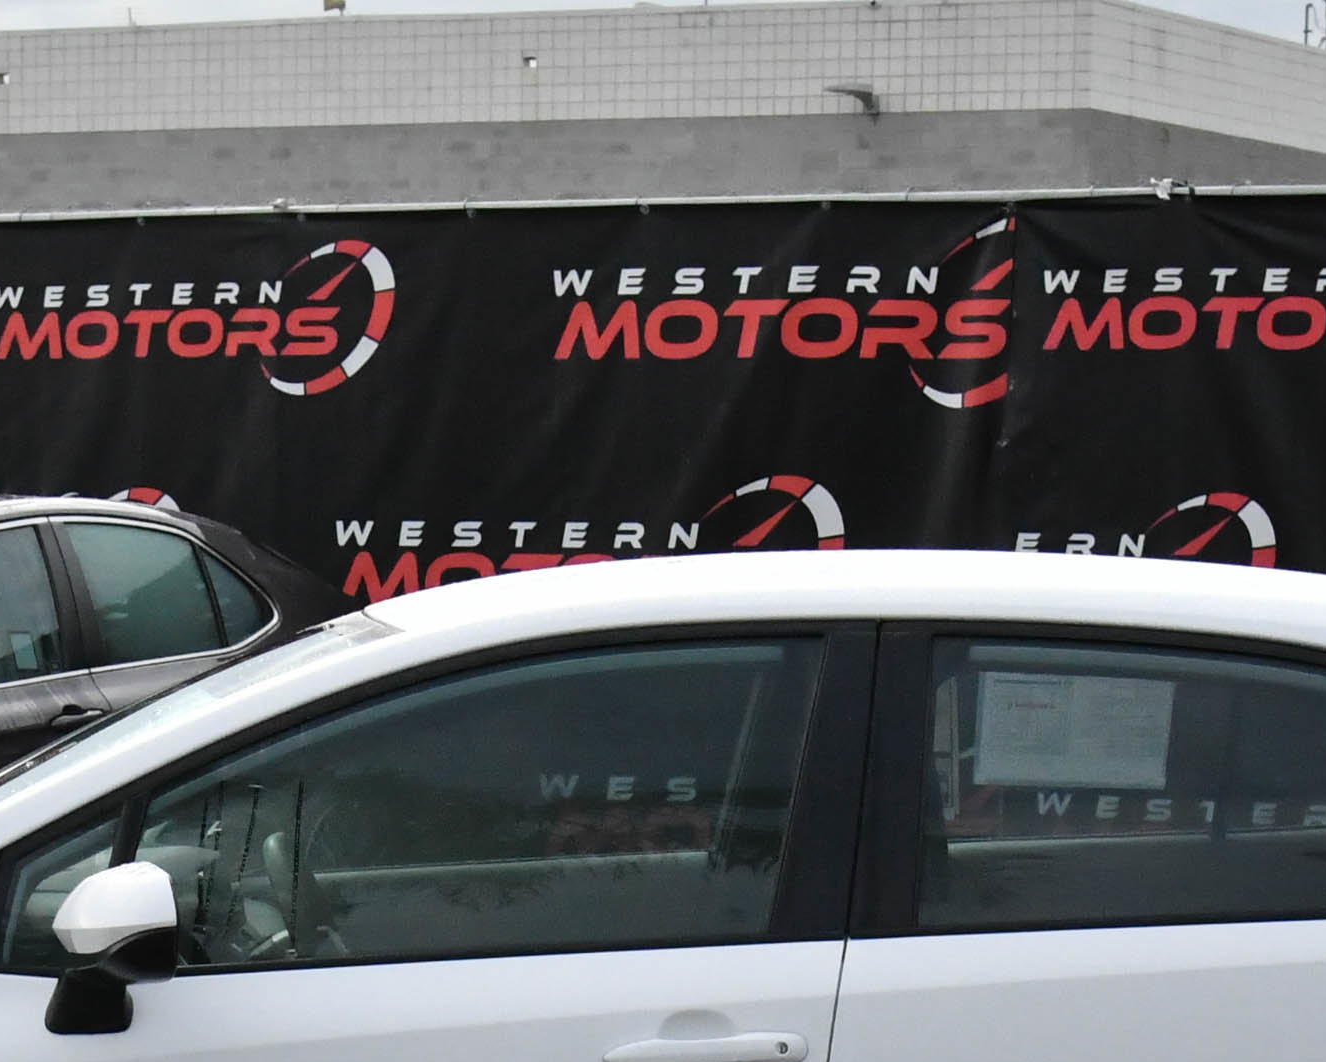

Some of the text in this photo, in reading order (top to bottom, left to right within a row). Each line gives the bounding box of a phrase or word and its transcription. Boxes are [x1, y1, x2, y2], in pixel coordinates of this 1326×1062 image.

[553, 266, 939, 296] WESTERN
[554, 298, 1011, 361] MOTORS
[335, 520, 700, 550] WESTERN
